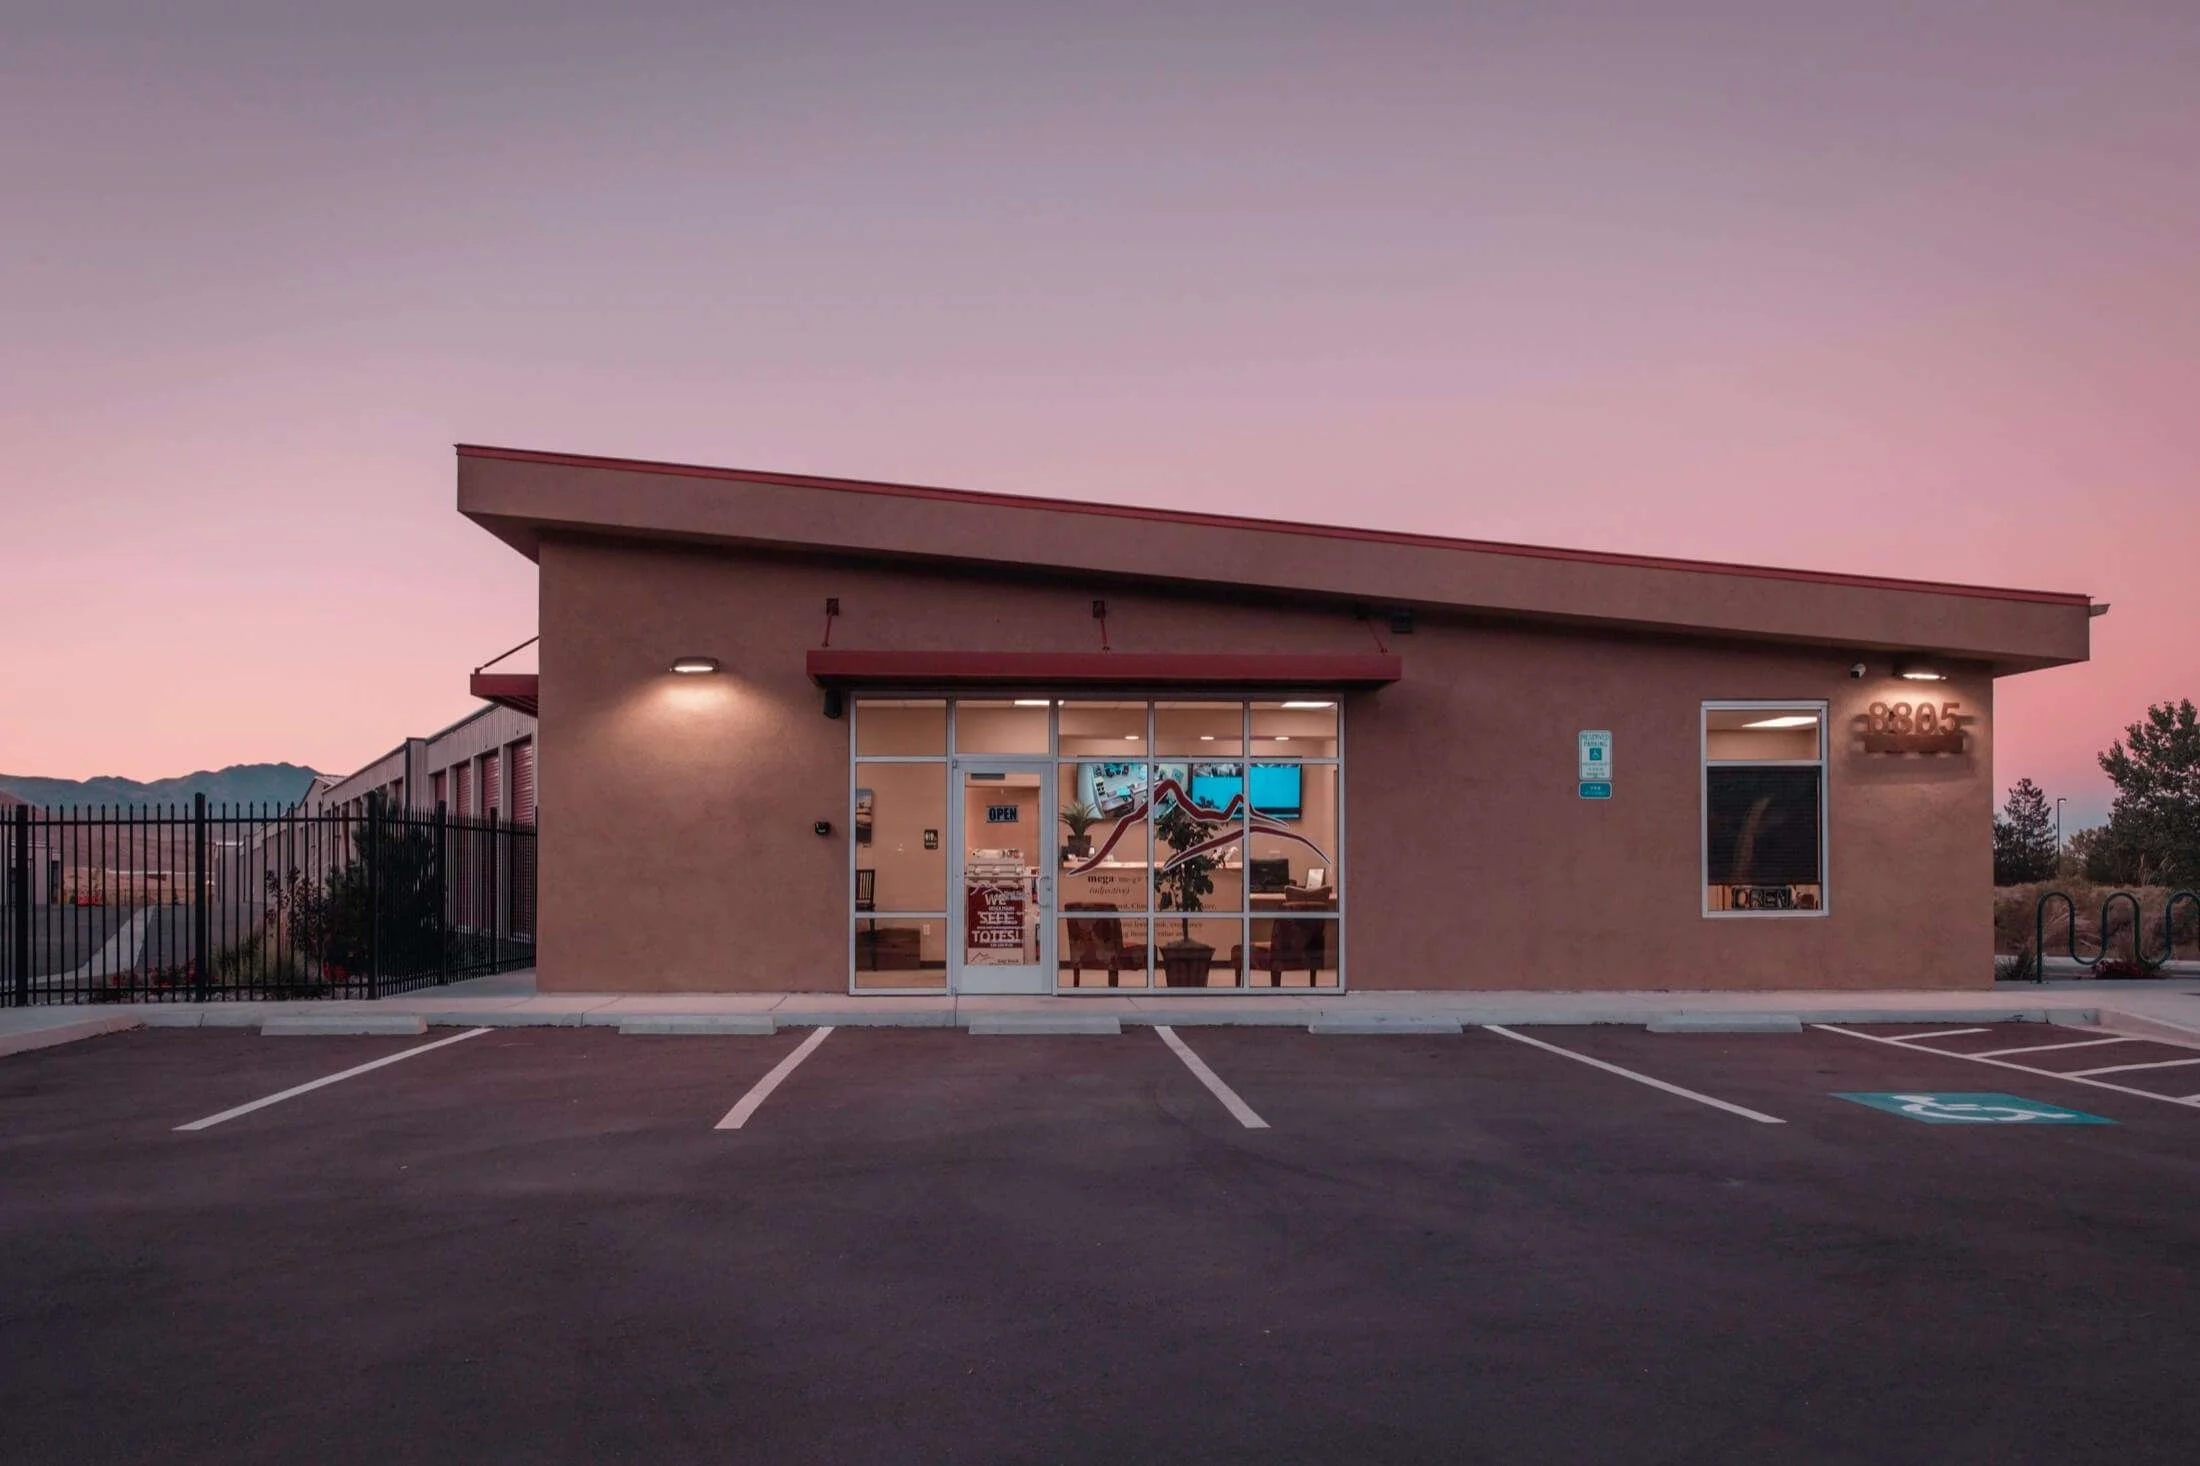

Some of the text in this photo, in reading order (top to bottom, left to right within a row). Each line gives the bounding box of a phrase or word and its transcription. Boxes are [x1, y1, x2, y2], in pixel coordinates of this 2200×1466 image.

[1868, 702, 1961, 736] 8805
[988, 807, 1018, 821] OPEN
[1087, 875, 1114, 884] mega
